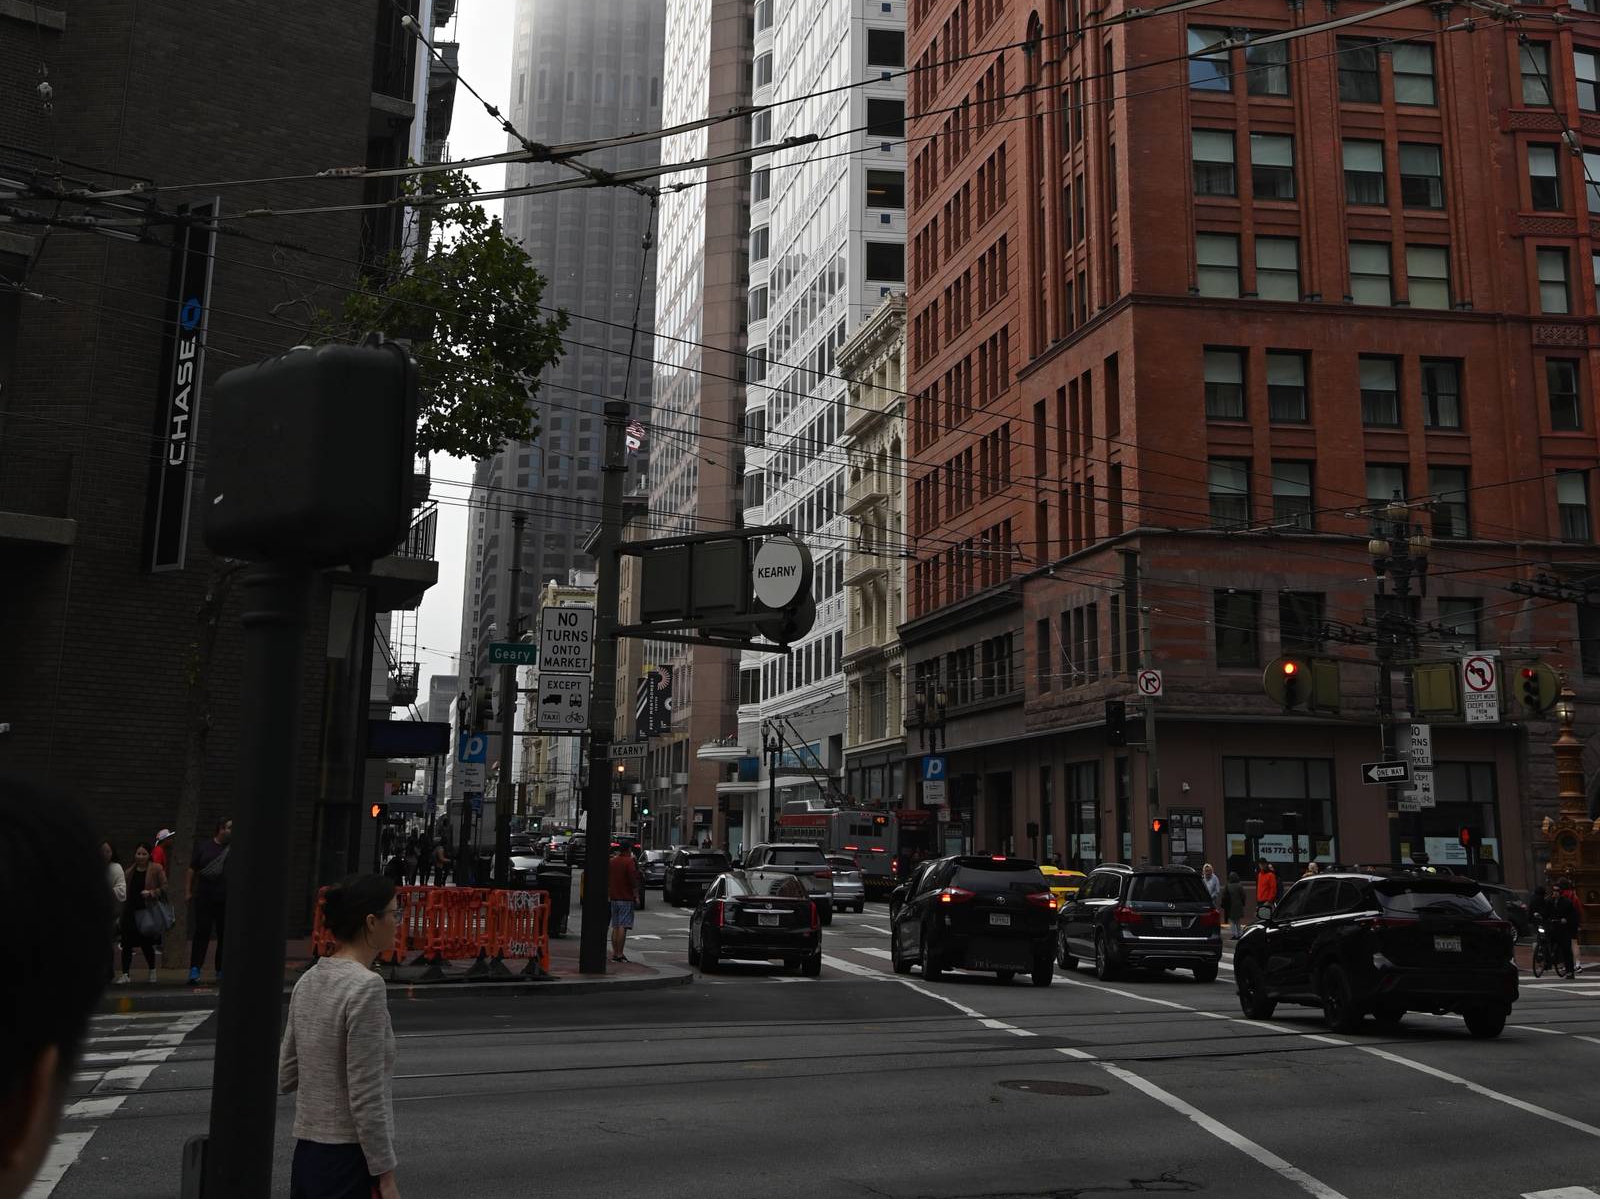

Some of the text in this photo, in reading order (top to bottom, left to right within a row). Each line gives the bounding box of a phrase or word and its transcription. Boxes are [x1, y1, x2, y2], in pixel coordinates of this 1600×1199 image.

[168, 335, 197, 466] CHASE
[757, 565, 797, 579] KEARNY
[557, 612, 579, 627] NO
[545, 629, 588, 643] TURNS
[494, 648, 531, 661] Geary
[552, 645, 581, 656] ONTO
[544, 657, 588, 669] MARKET
[547, 680, 582, 691] EXCEPT
[543, 713, 559, 721] TAXI
[1411, 738, 1428, 747] RNS
[612, 745, 645, 756] KEARNY
[1411, 748, 1424, 756] NTO
[1411, 756, 1429, 764] RKET
[1376, 767, 1403, 777] ONE WAY
[1260, 846, 1273, 855] 415
